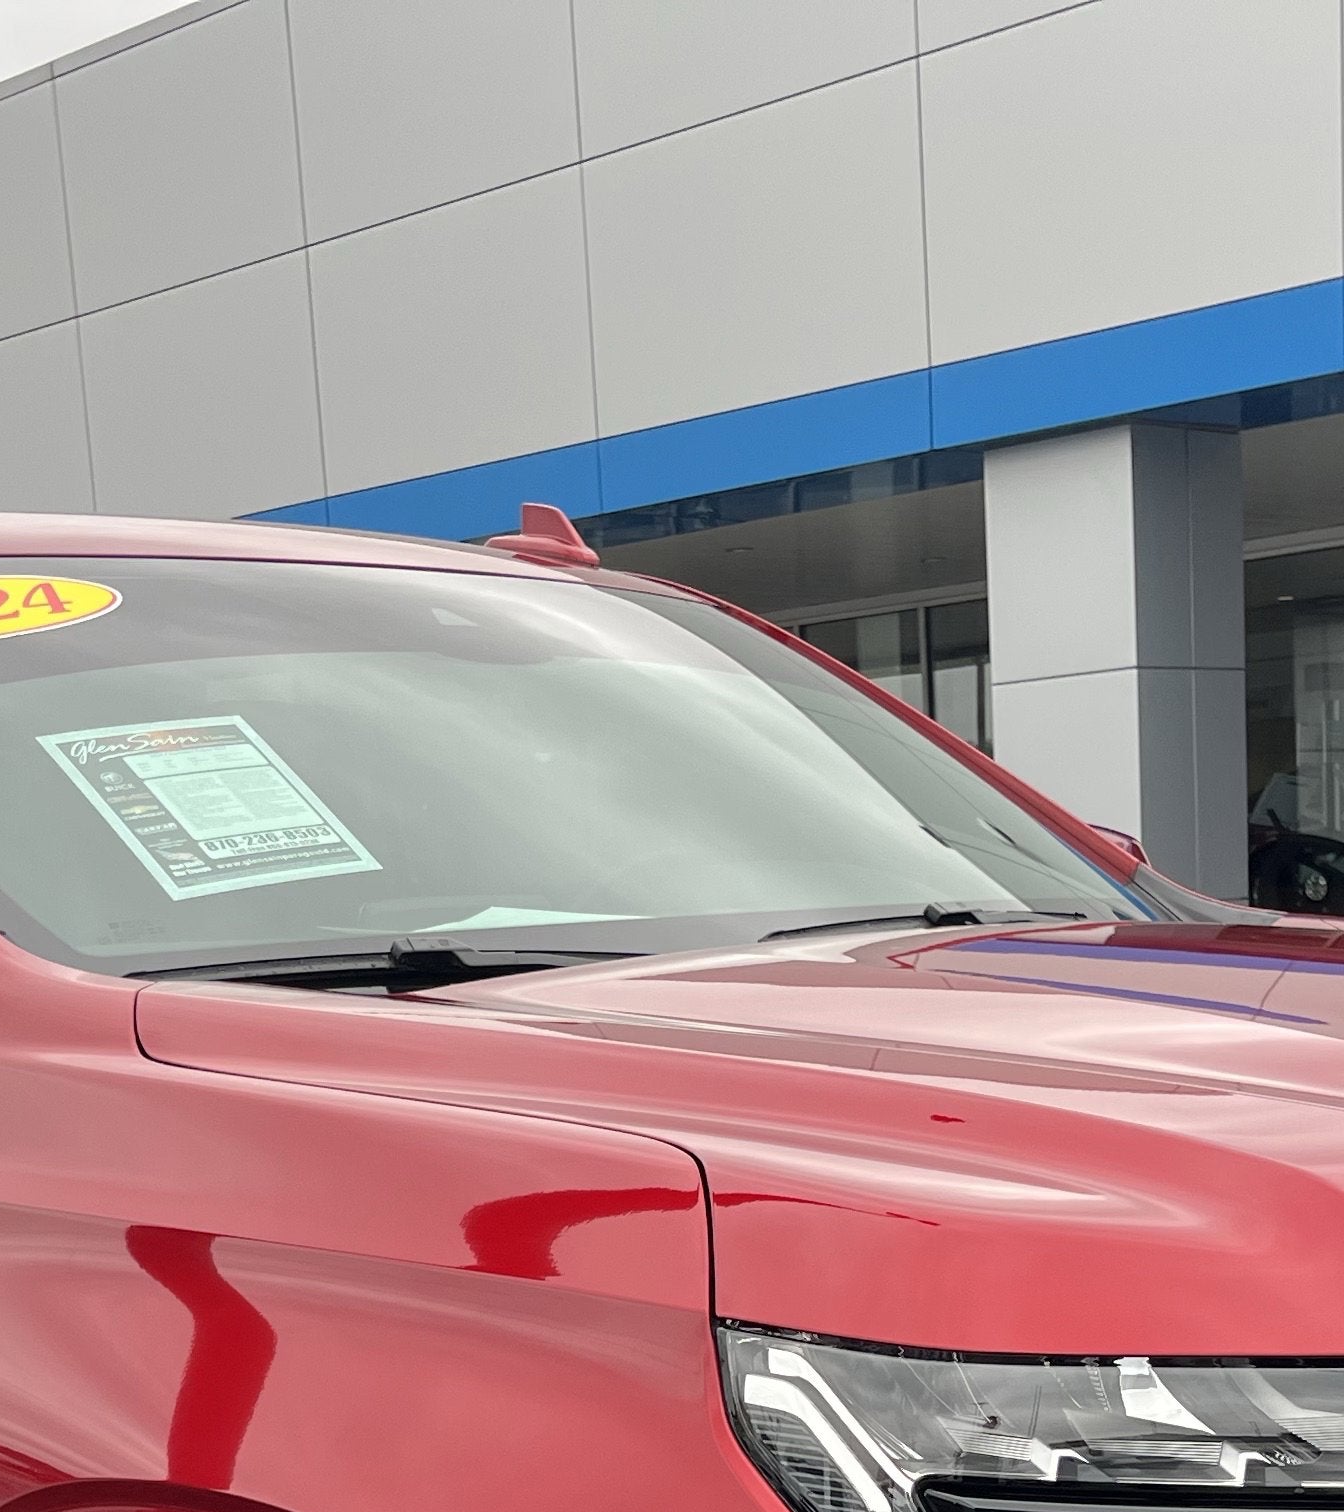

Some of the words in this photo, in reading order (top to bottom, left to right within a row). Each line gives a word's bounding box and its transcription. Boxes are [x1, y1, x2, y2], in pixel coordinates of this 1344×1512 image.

[70, 739, 130, 765] Glen
[127, 732, 199, 750] Sain
[203, 826, 331, 852] 870-236-8503
